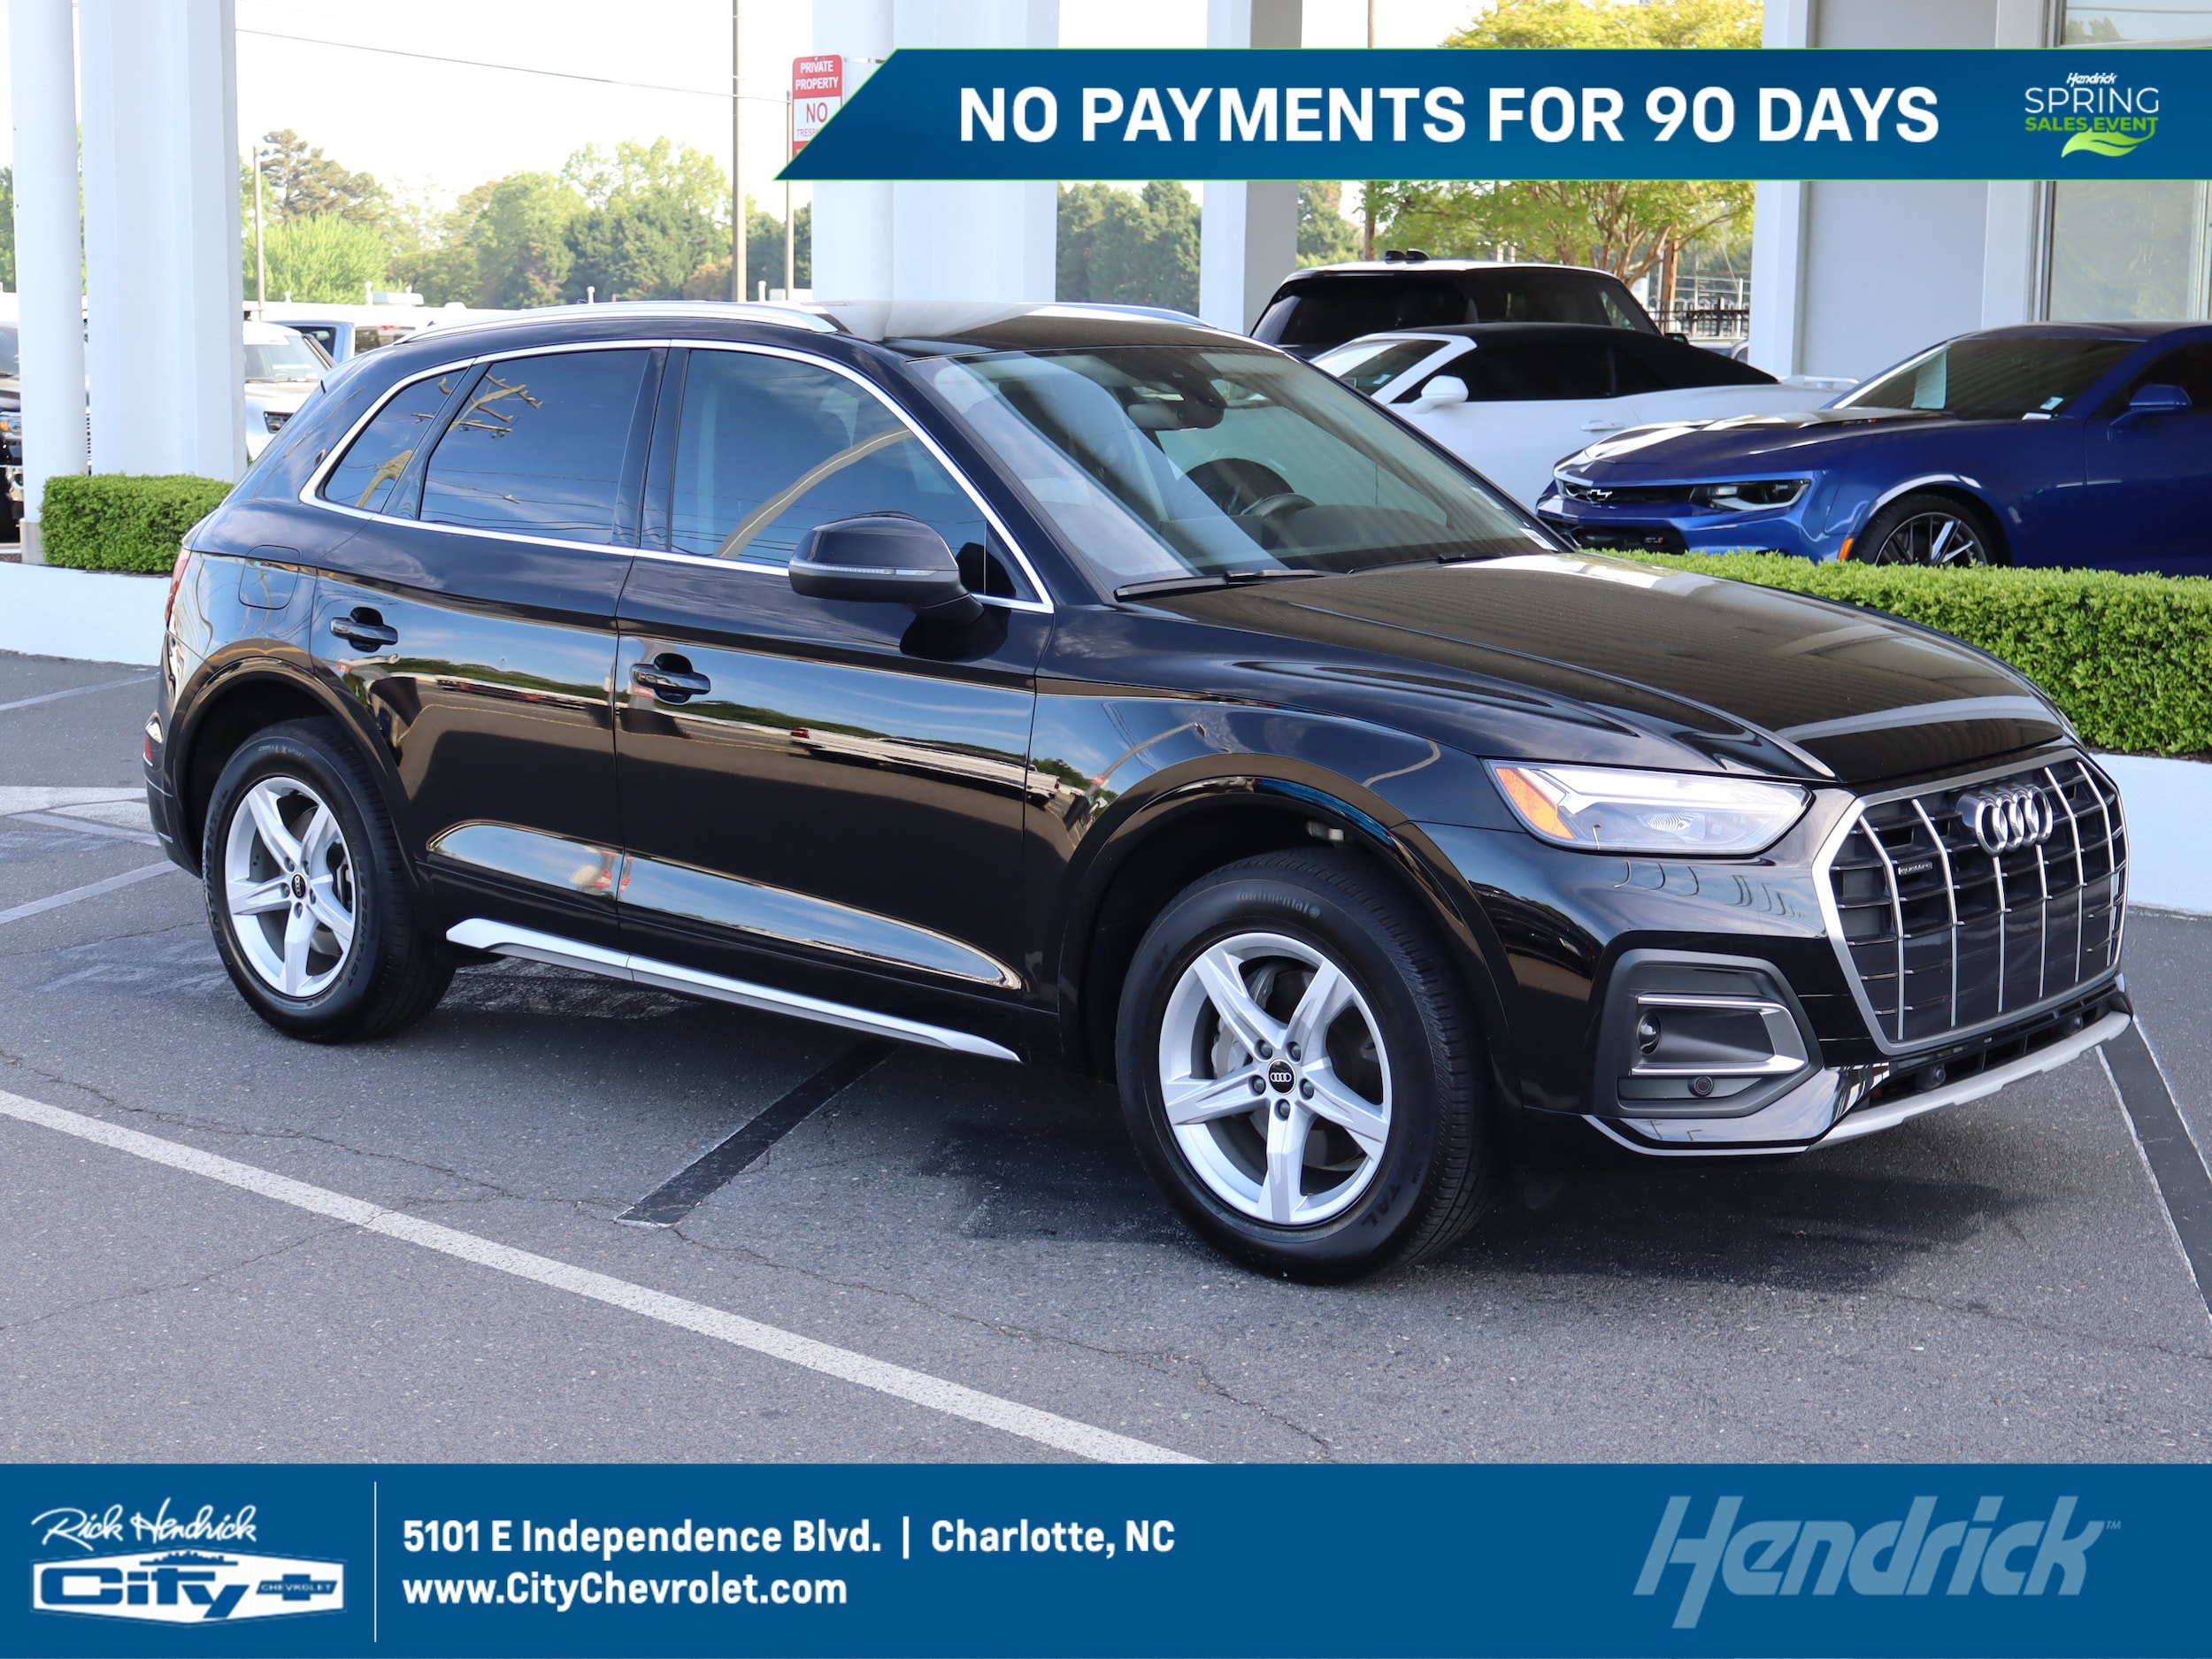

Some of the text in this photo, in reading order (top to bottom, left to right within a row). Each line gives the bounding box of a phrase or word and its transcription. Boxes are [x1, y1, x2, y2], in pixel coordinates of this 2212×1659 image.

[800, 60, 834, 74] PRIVATE
[795, 76, 840, 90] PROPERTY
[806, 102, 828, 123] NO
